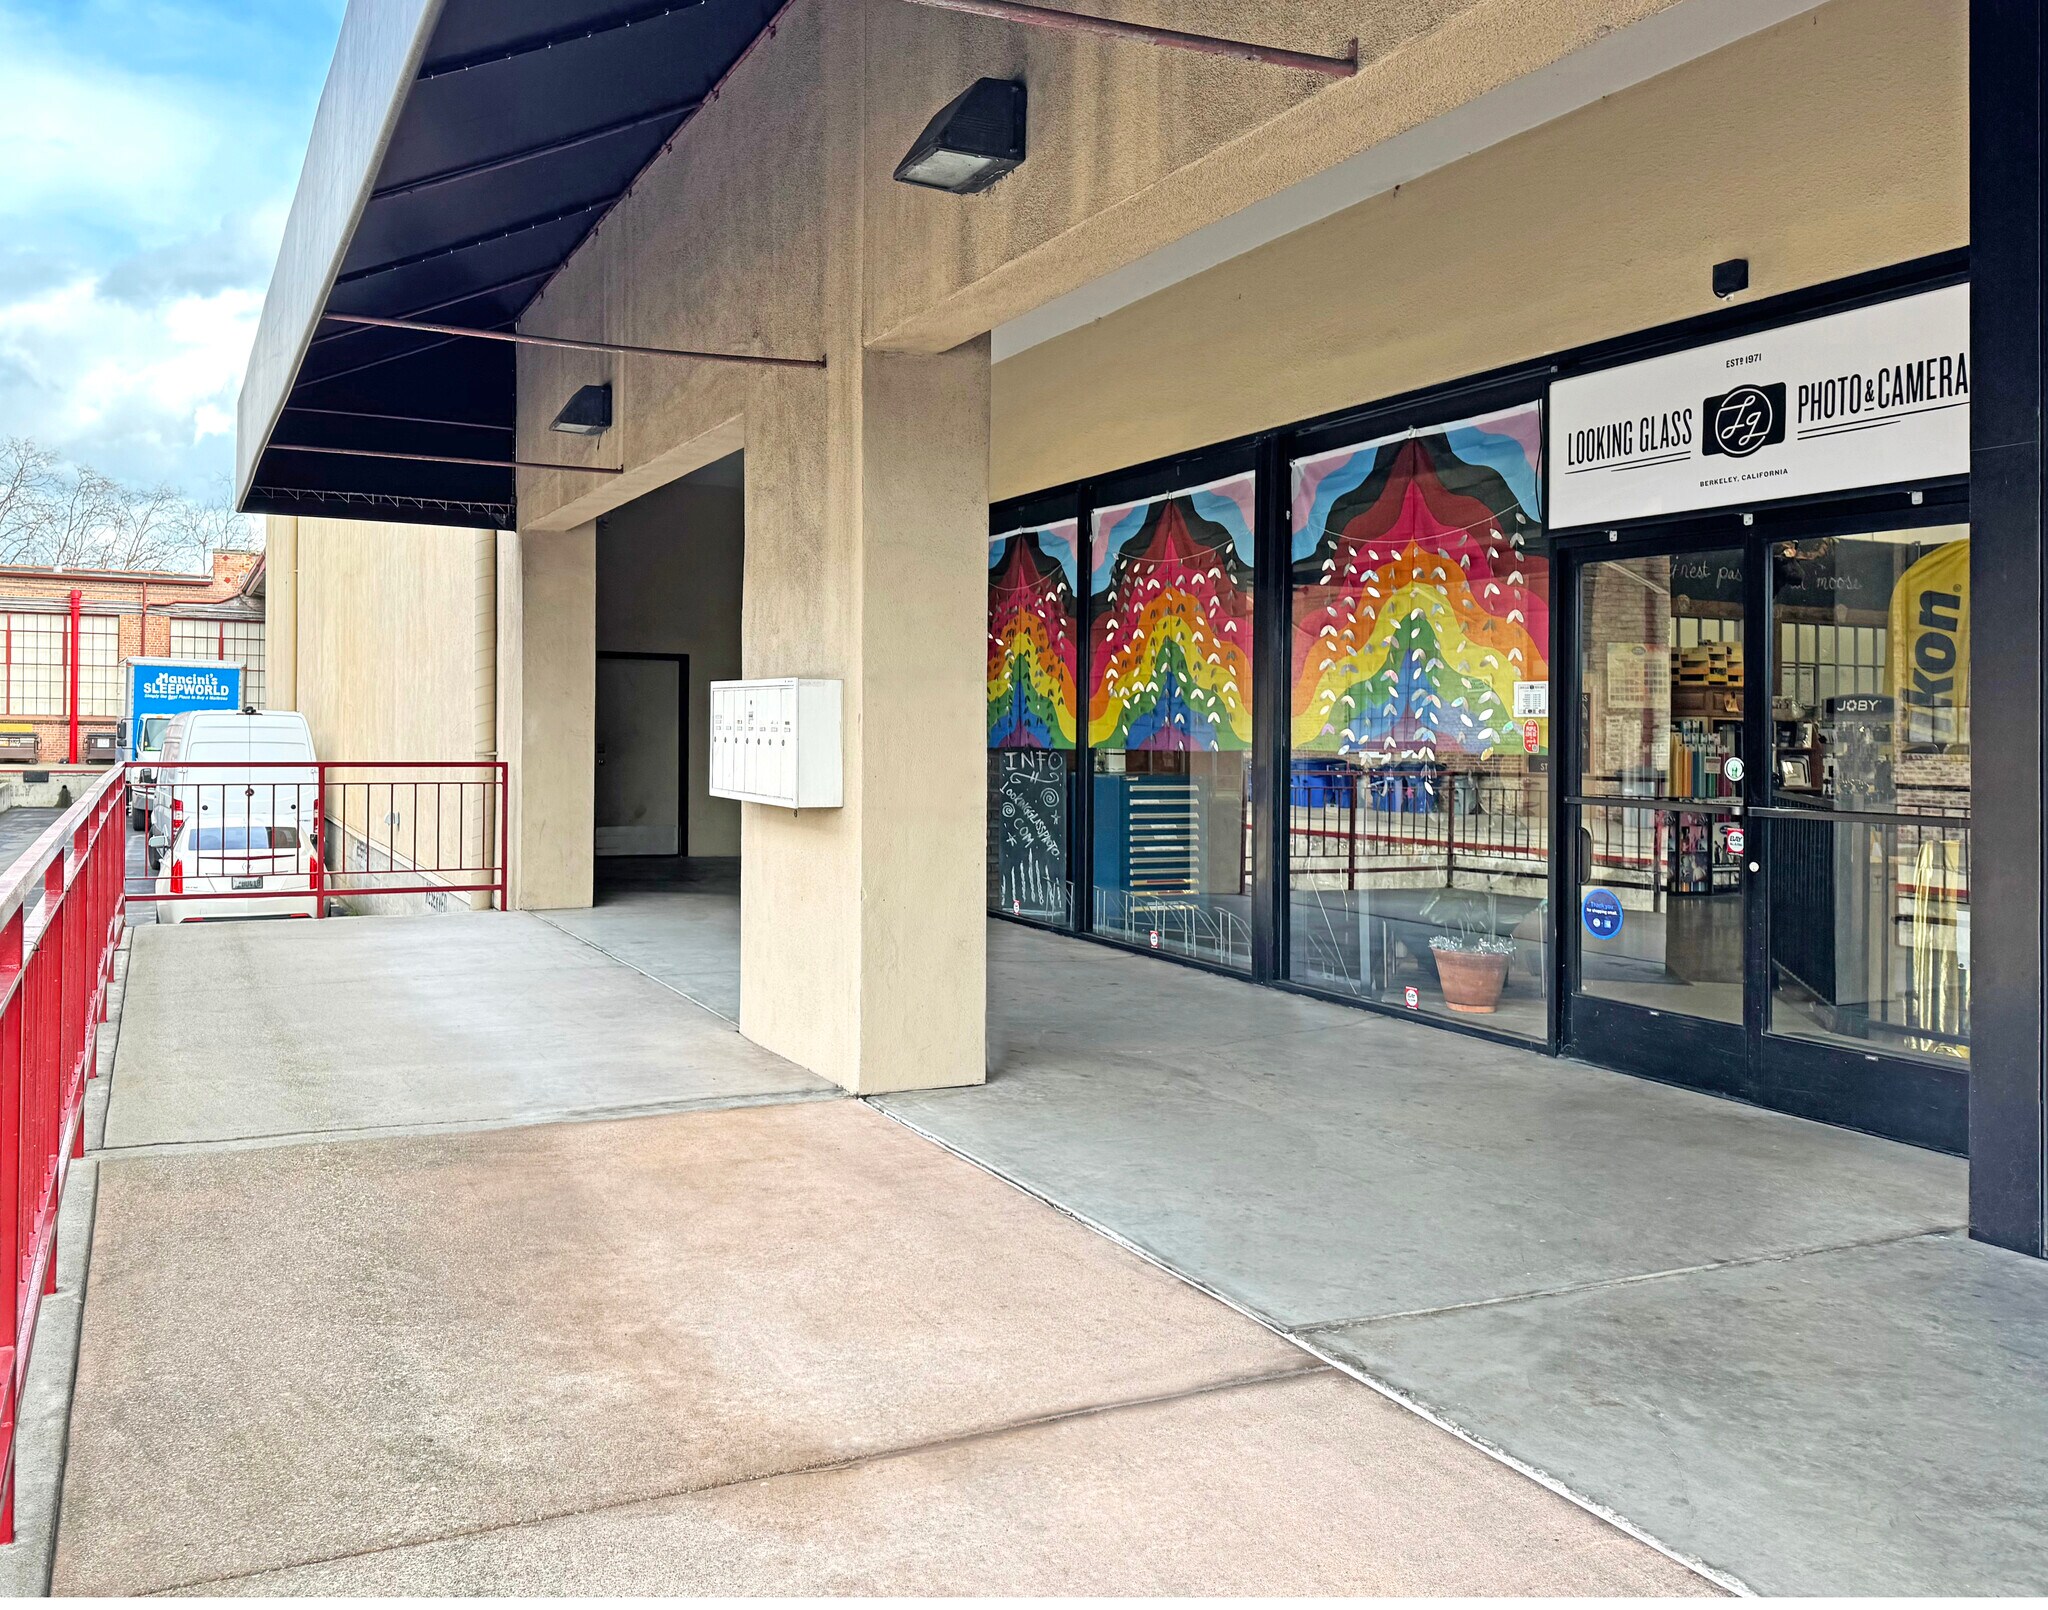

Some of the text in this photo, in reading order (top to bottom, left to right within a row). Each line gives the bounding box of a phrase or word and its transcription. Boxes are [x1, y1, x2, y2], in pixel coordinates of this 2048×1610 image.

[1745, 353, 1762, 364] 1971
[1568, 408, 1693, 467] LOOKING GLASS
[1699, 468, 1789, 488] BERKELEY, CALIFORNIA
[1716, 566, 1743, 589] pas
[1899, 590, 1961, 707] kon
[143, 682, 229, 696] SLEEPWORLD
[155, 672, 218, 686] Mancini's
[1836, 699, 1879, 712] JOBY
[1004, 750, 1063, 772] INFO
[1013, 818, 1035, 848] COM
